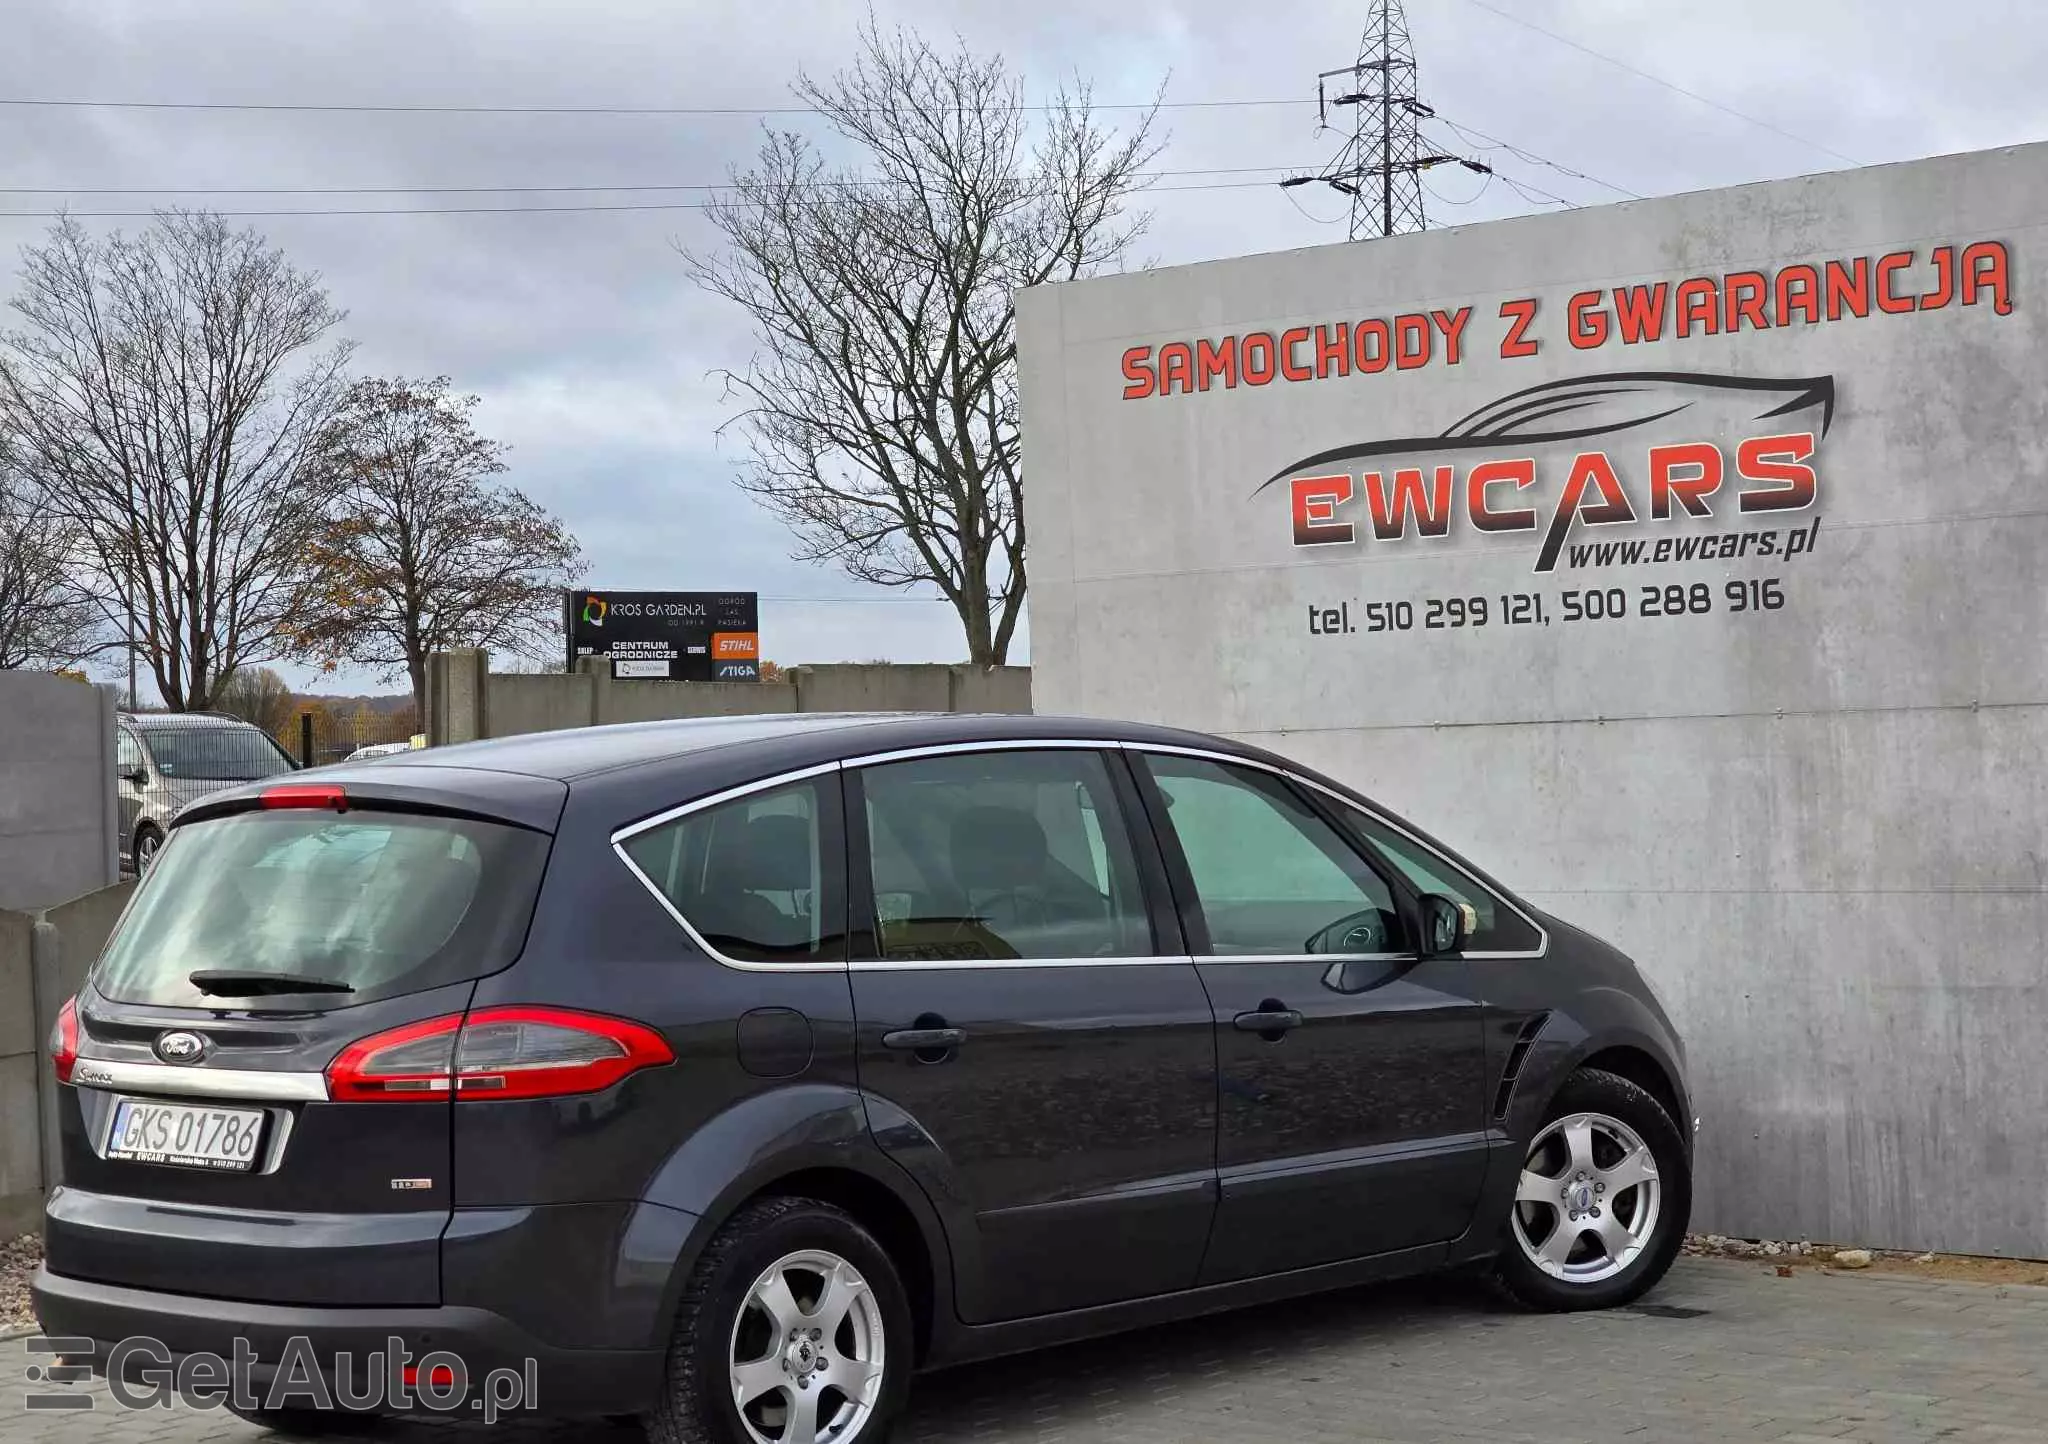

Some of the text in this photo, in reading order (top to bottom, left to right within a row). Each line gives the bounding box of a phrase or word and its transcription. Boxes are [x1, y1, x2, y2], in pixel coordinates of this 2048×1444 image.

[1122, 240, 2013, 400] SAMOCHODY Z GWARANCJĄ
[1290, 432, 1817, 573] EWCARS
[1569, 517, 1822, 569] www.ewcars.pl
[611, 603, 707, 616] KROS GARDEN.PL
[1308, 579, 1785, 635] tel. 510 299 121, 500 288 916
[612, 641, 669, 650] CENTRUM
[719, 640, 754, 651] STIHL
[603, 650, 678, 659] OGRODNICZE
[719, 666, 755, 676] STIGA
[123, 1107, 259, 1156] GKS 01786
[136, 1151, 165, 1162] EWCARS
